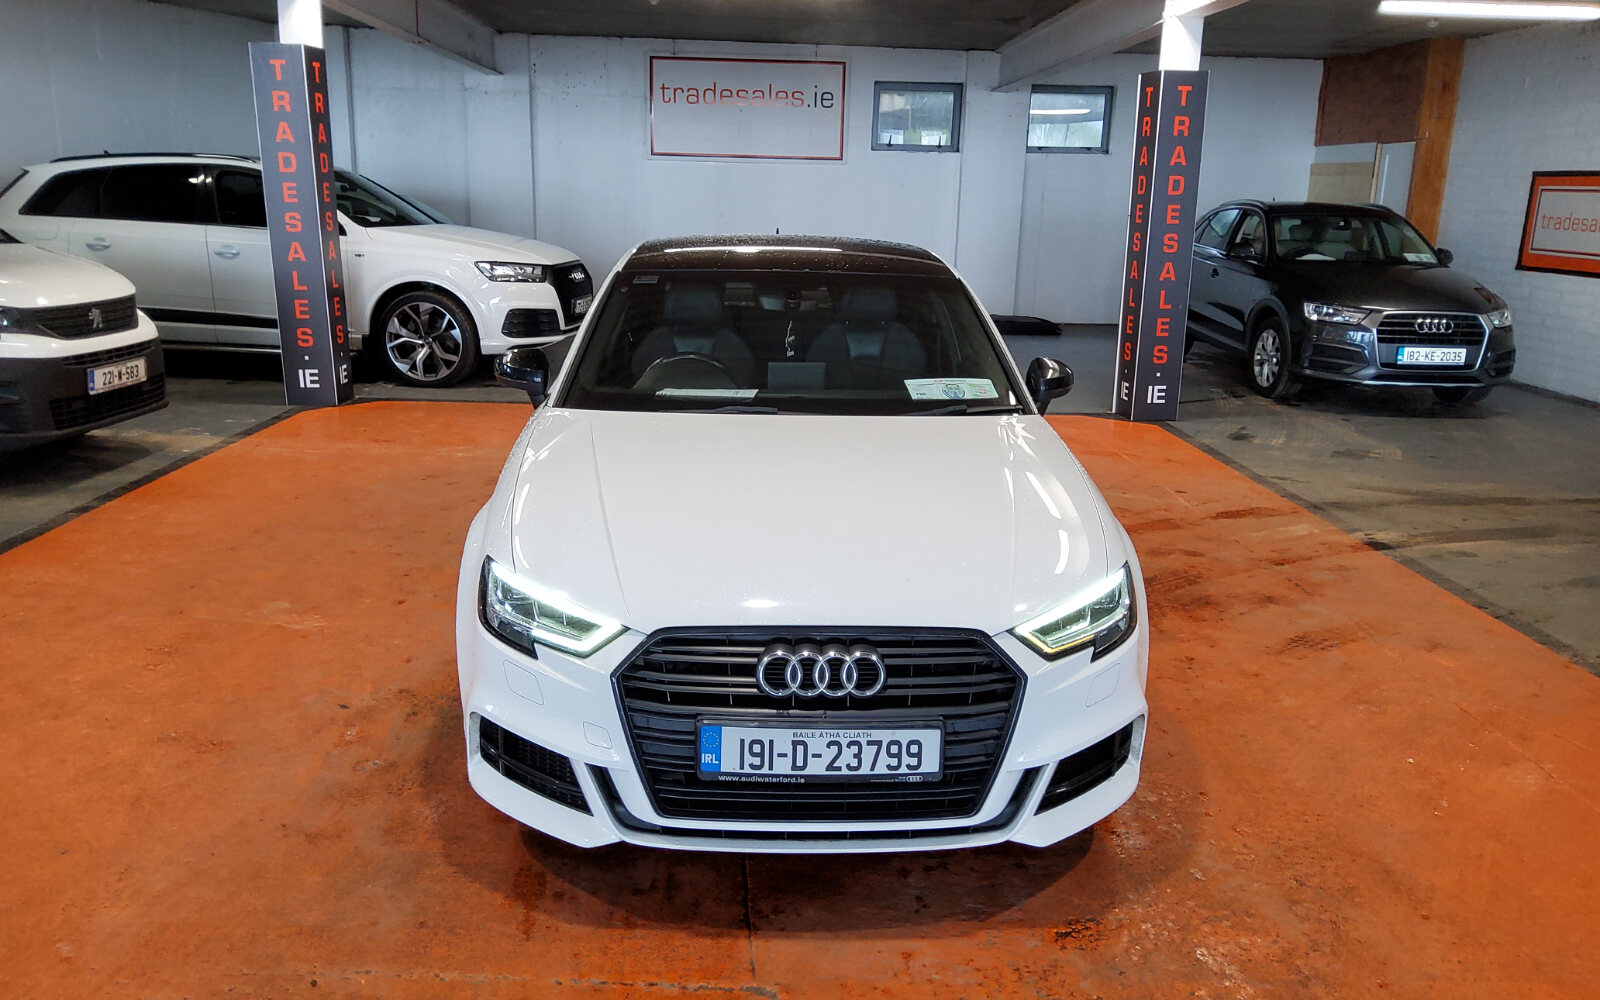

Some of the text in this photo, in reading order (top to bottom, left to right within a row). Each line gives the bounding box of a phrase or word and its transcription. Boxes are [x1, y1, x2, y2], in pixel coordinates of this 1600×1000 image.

[660, 81, 834, 109] tradesales.ie
[268, 58, 321, 388] TRADESALES.IE
[312, 61, 349, 385] TRADESALES.IE
[1120, 86, 1154, 401] TRADESALES.IE
[1146, 85, 1193, 404] TRADESALES.IE
[1406, 350, 1463, 362] 182-KE-2035
[792, 731, 817, 739] BAILE
[842, 731, 872, 739] CLIATH
[701, 753, 719, 764] IRL
[739, 739, 923, 772] 191-D-23799
[718, 775, 805, 784] www.audiwaterford.ie
